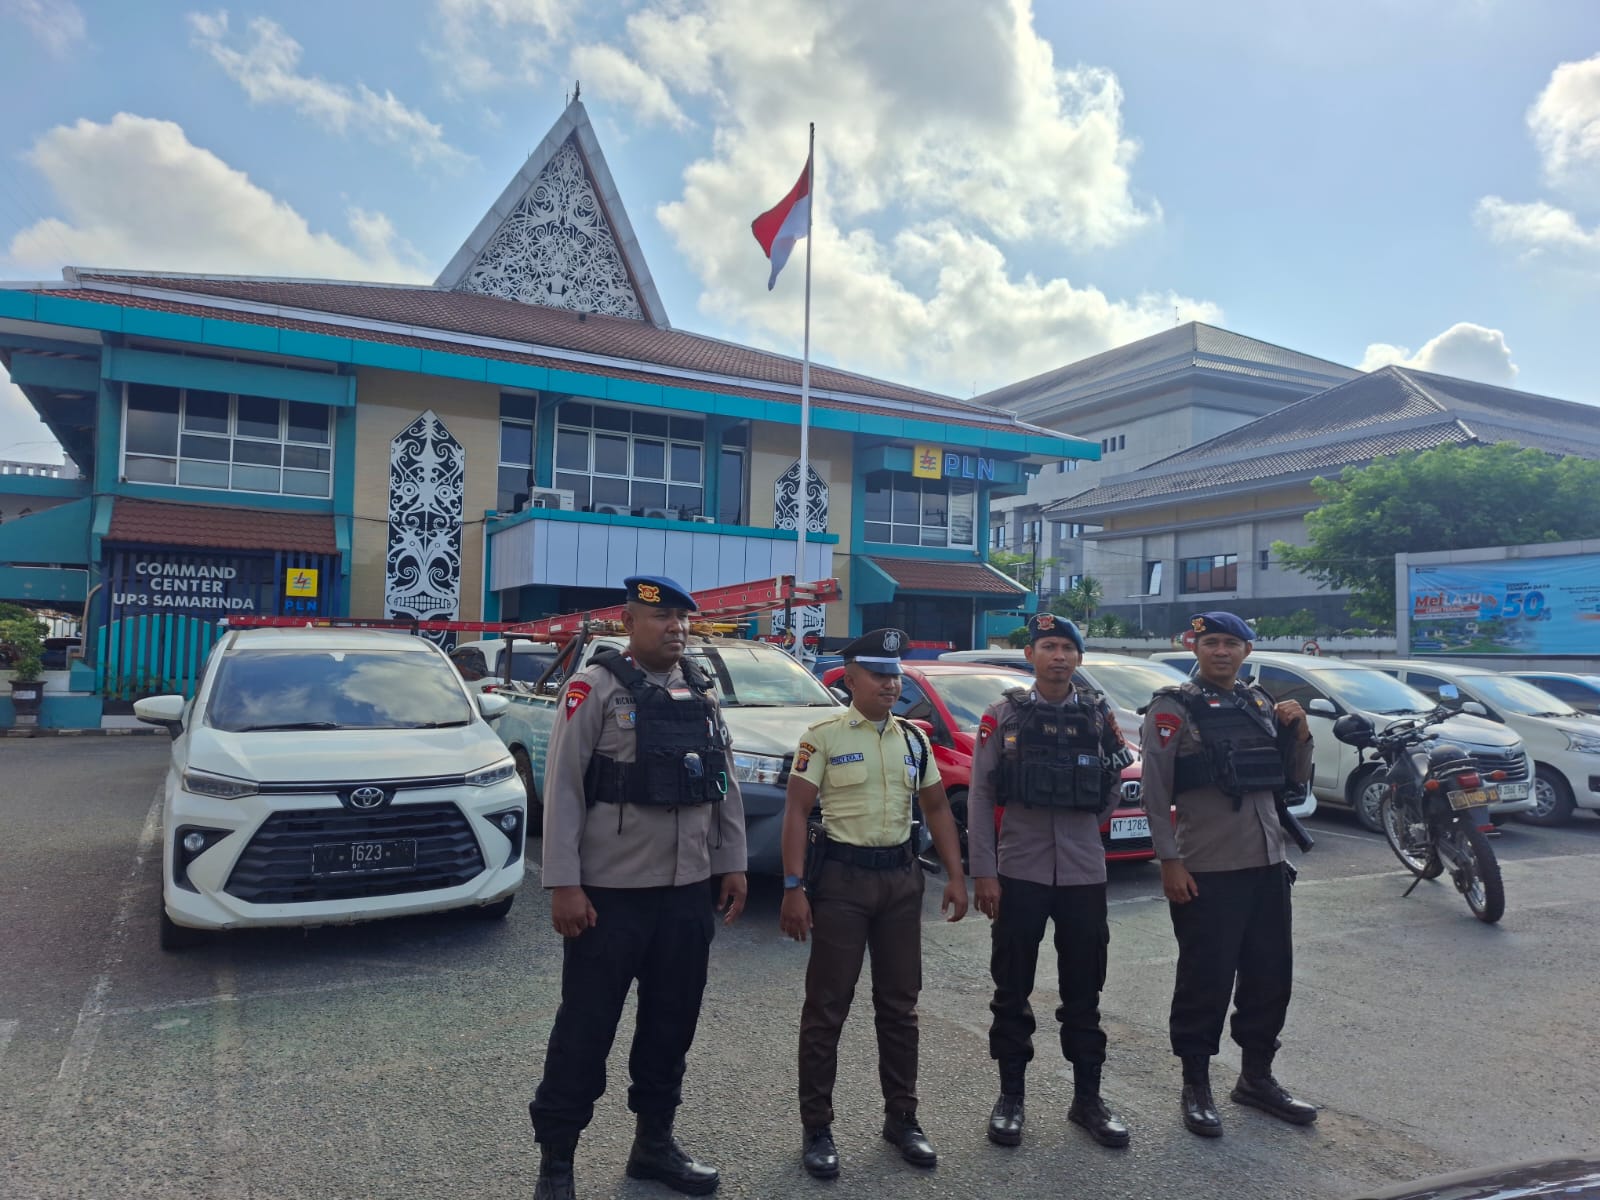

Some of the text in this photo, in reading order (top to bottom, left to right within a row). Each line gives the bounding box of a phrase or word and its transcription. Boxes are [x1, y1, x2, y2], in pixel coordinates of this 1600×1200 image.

[944, 453, 995, 480] PLN
[135, 562, 237, 580] COMMAND
[150, 577, 223, 593] CENTER
[113, 592, 255, 610] UP3 SAMARINDA
[285, 600, 318, 611] PLN
[1112, 820, 1123, 833] KT
[351, 844, 382, 862] 1623
